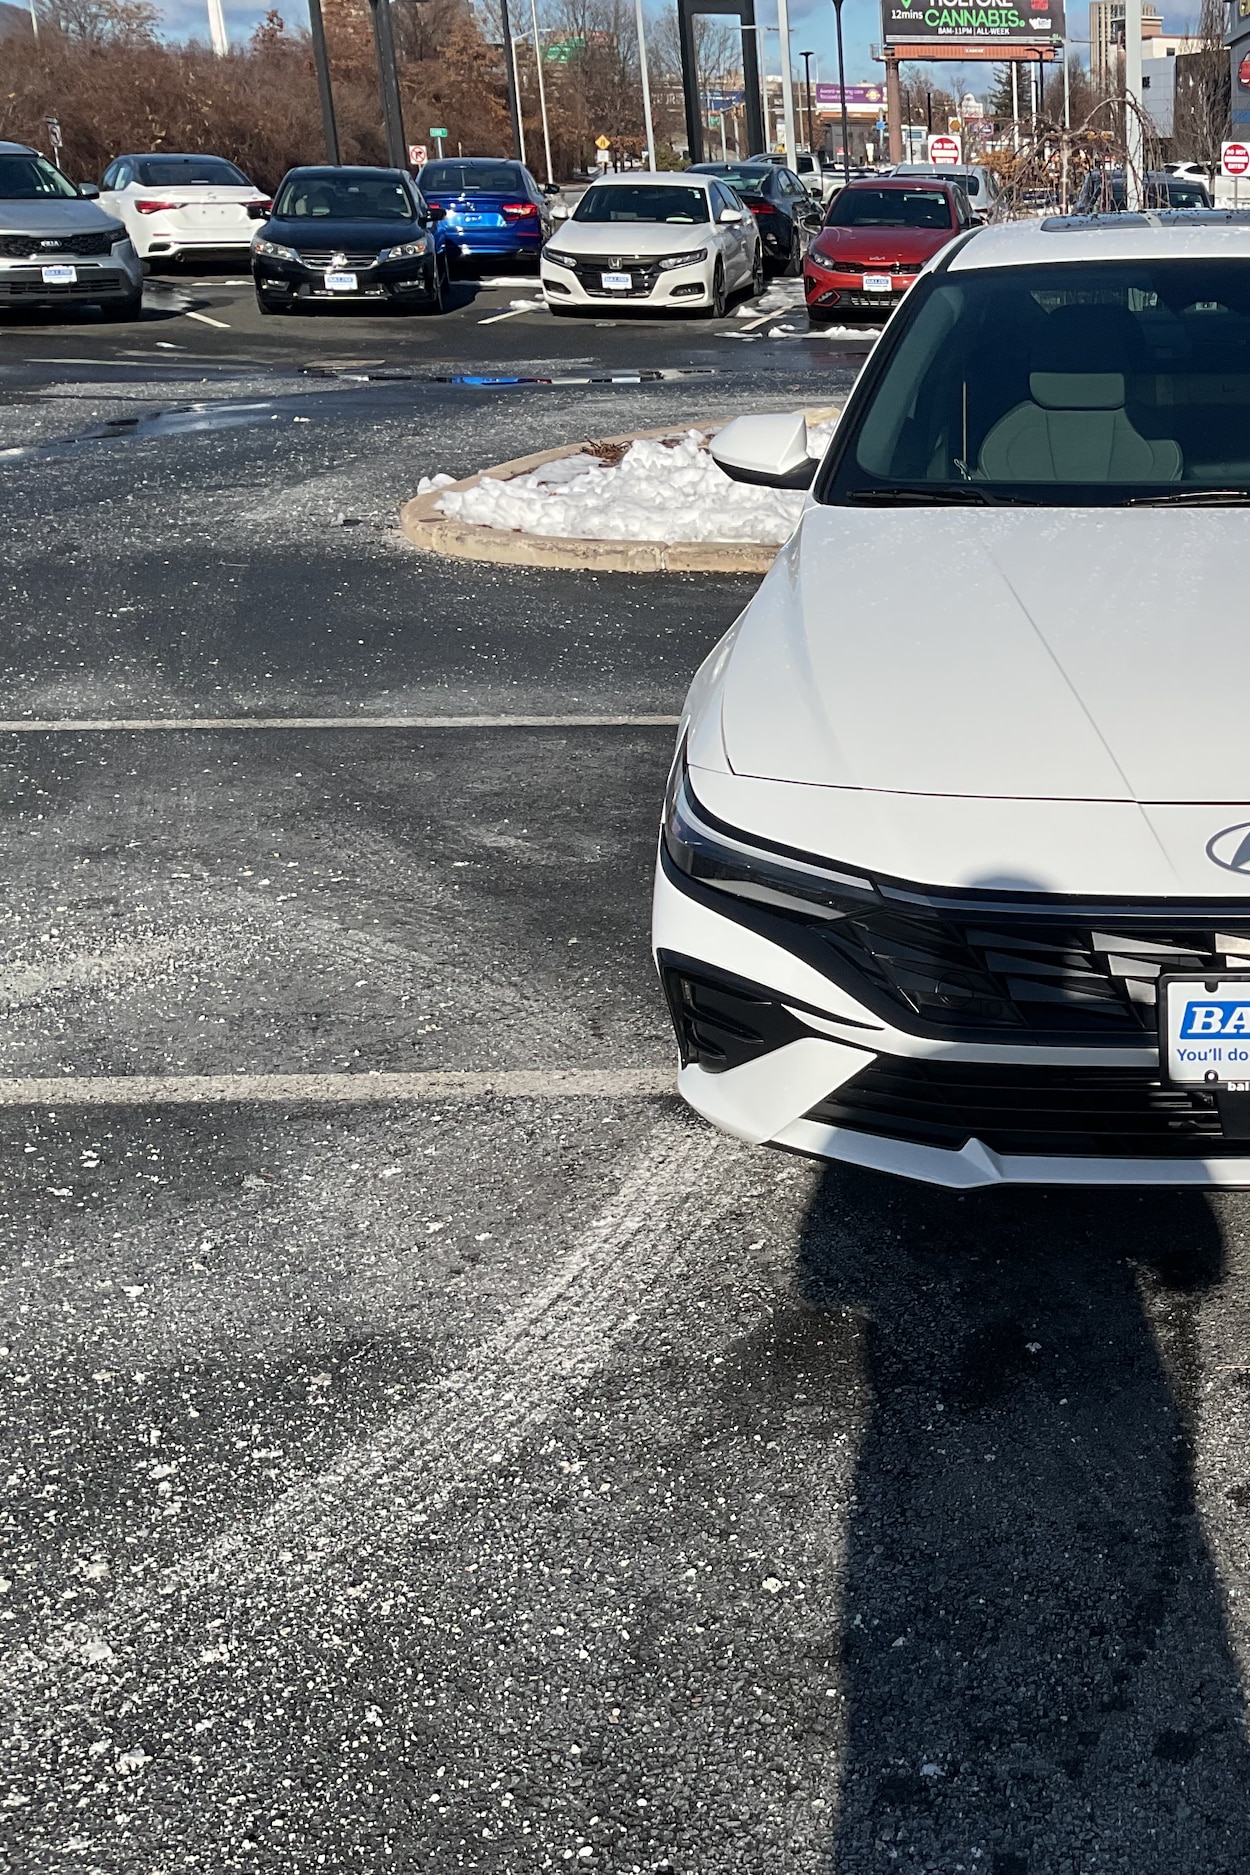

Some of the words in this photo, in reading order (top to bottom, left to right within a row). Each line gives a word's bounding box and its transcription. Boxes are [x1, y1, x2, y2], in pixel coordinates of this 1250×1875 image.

[892, 9, 923, 19] 12mins
[976, 27, 1010, 35] ALL-WEEK
[1177, 1048, 1222, 1061] You'll
[1228, 1047, 1249, 1061] do
